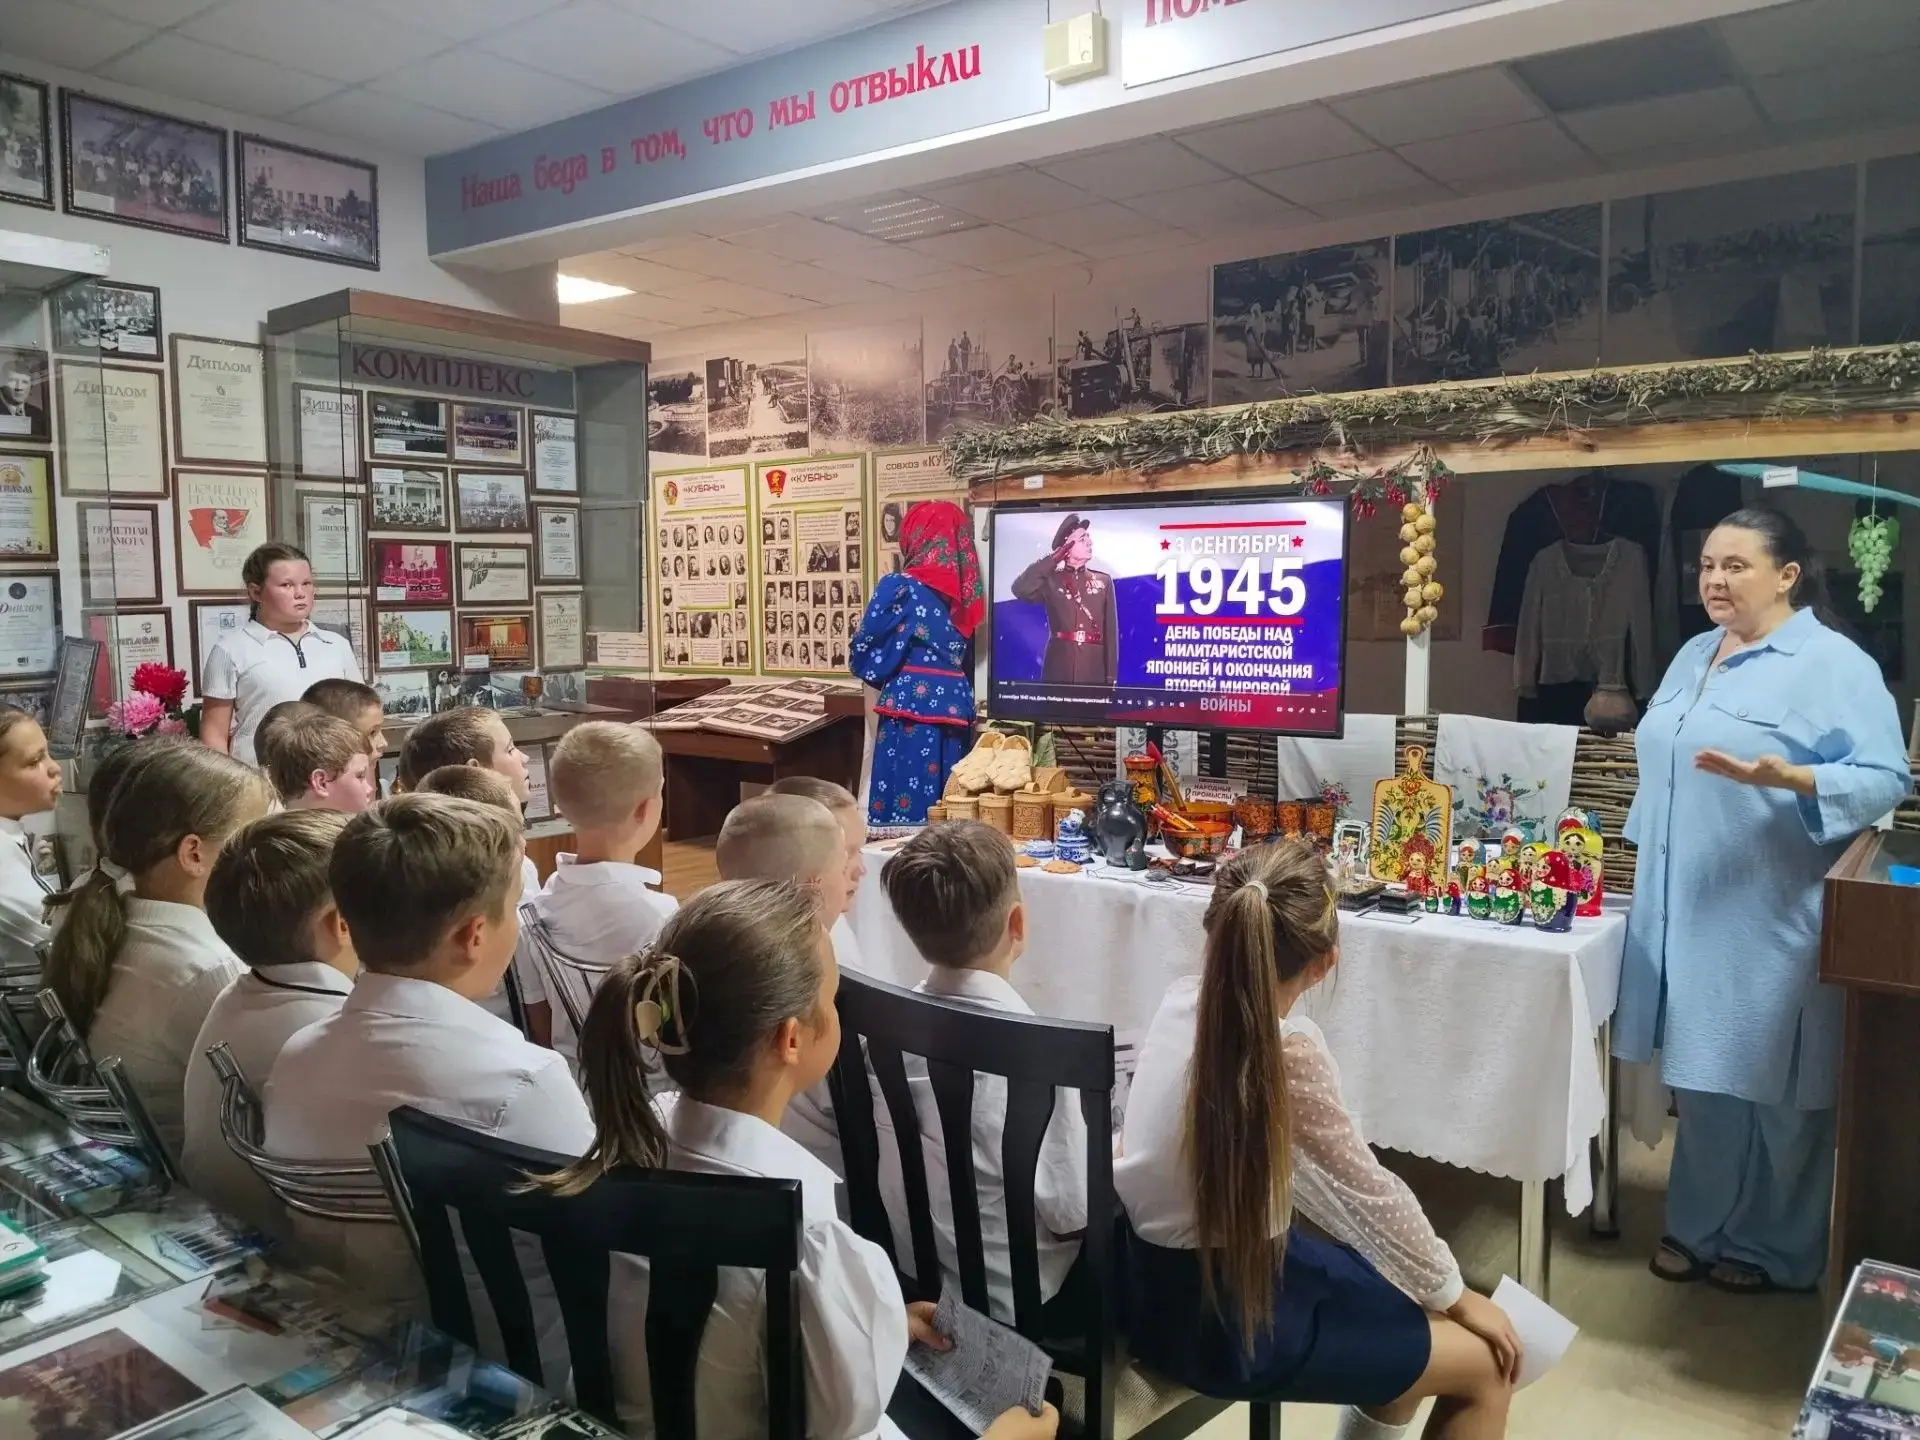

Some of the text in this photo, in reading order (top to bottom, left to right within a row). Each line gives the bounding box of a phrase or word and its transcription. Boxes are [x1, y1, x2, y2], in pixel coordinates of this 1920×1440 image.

[460, 44, 981, 211] Наша беда в том, что мы отвыкли
[352, 346, 535, 398] КОМПЛЕКС
[790, 472, 839, 483] «КУБАНЬ»
[683, 484, 726, 493] «КУБАНЬ»
[1191, 533, 1290, 554] СЕНТЯБРЯ
[1155, 556, 1307, 616] 1945
[1165, 625, 1294, 643] ДЕНЬ ПОБЕДЫ НАД
[1165, 640, 1293, 660] МИЛИТАРИСТСКОЙ
[1146, 659, 1313, 679] ЯПОНИЕЙ И ОКОНЧАНИЯ
[1164, 675, 1291, 696] ВТОРОЙ МИРОВОЙ
[1200, 695, 1251, 712] ВОЙНЫ
[1192, 790, 1232, 800] ПРОМЫСЛЫ
[1194, 783, 1232, 793] НАРОДНЫЕ
